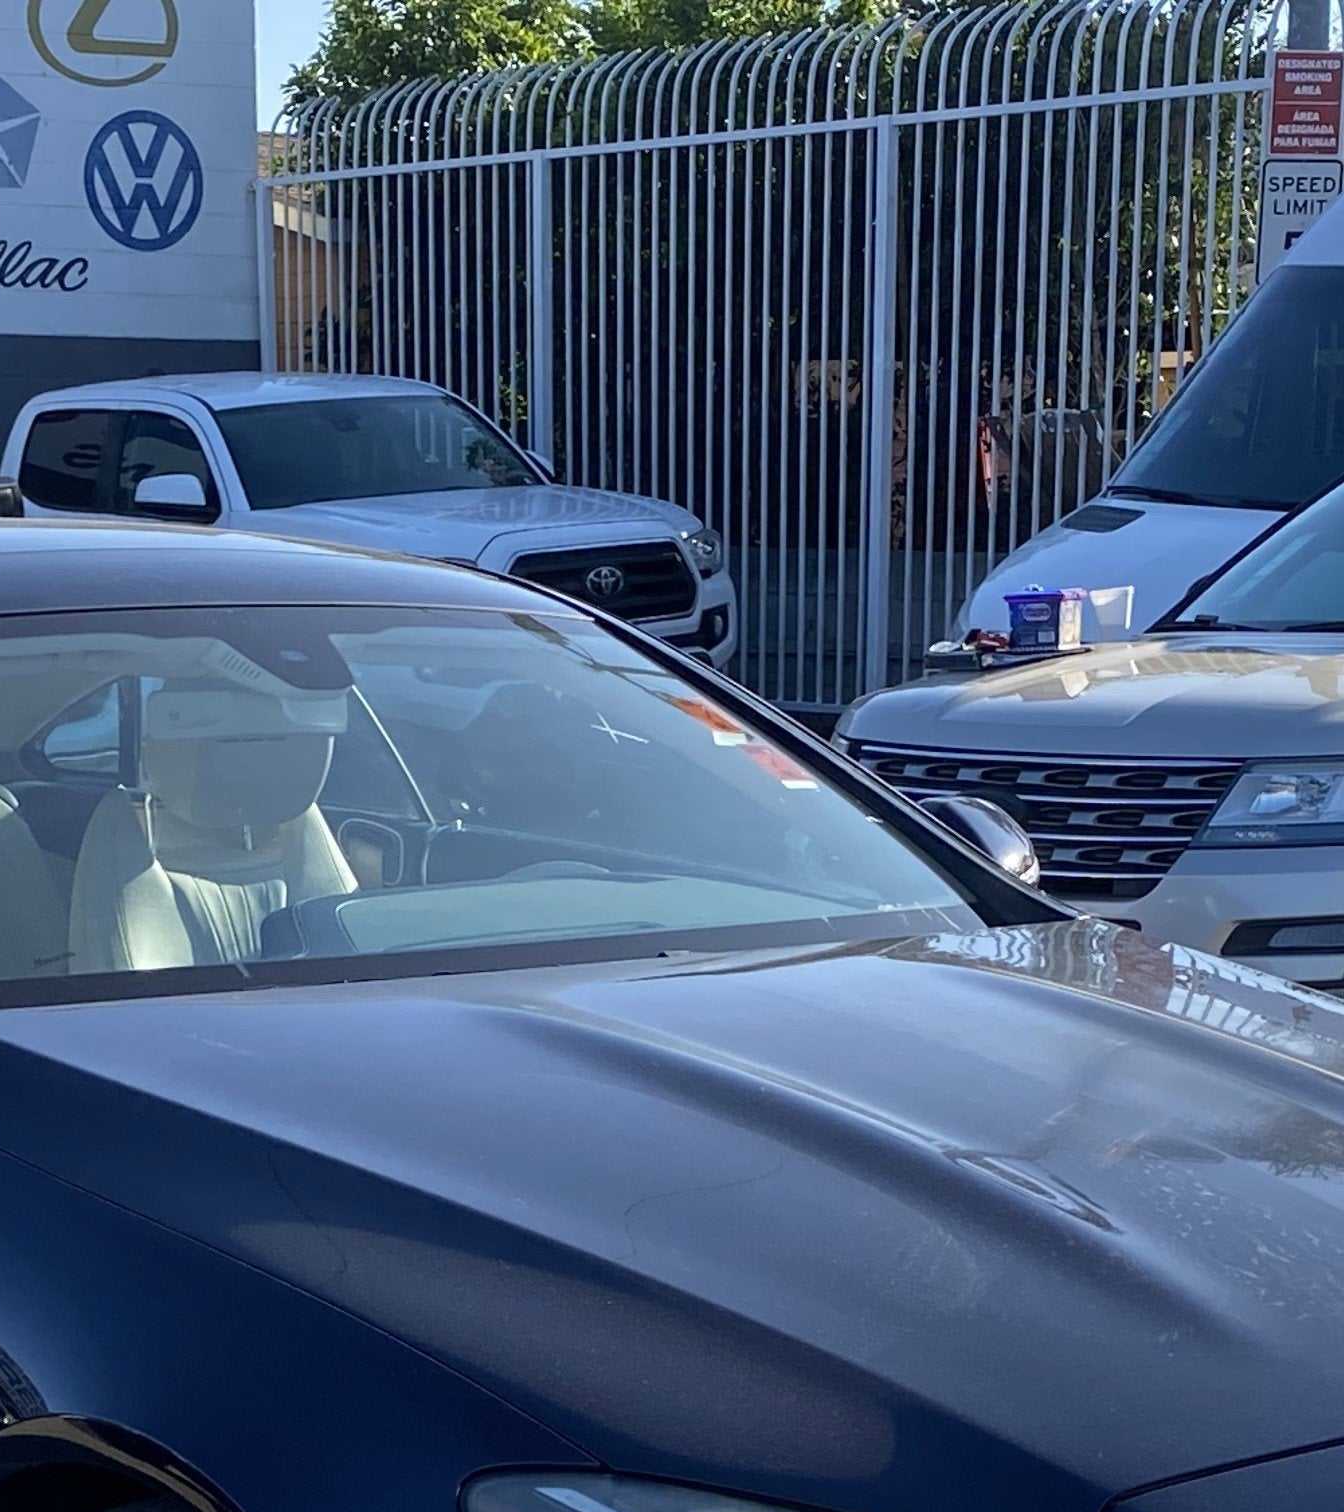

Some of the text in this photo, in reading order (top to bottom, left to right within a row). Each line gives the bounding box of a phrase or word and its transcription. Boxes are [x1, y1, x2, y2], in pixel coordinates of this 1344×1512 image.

[1278, 59, 1341, 69] DESIGNATED
[1285, 72, 1332, 82] SMOKING
[1294, 85, 1322, 95] AREA
[1277, 124, 1335, 134] DESIGNADA
[1273, 137, 1336, 147] PARA FUMAR
[1268, 176, 1336, 193] SPEED
[1273, 199, 1328, 215] LIMIT
